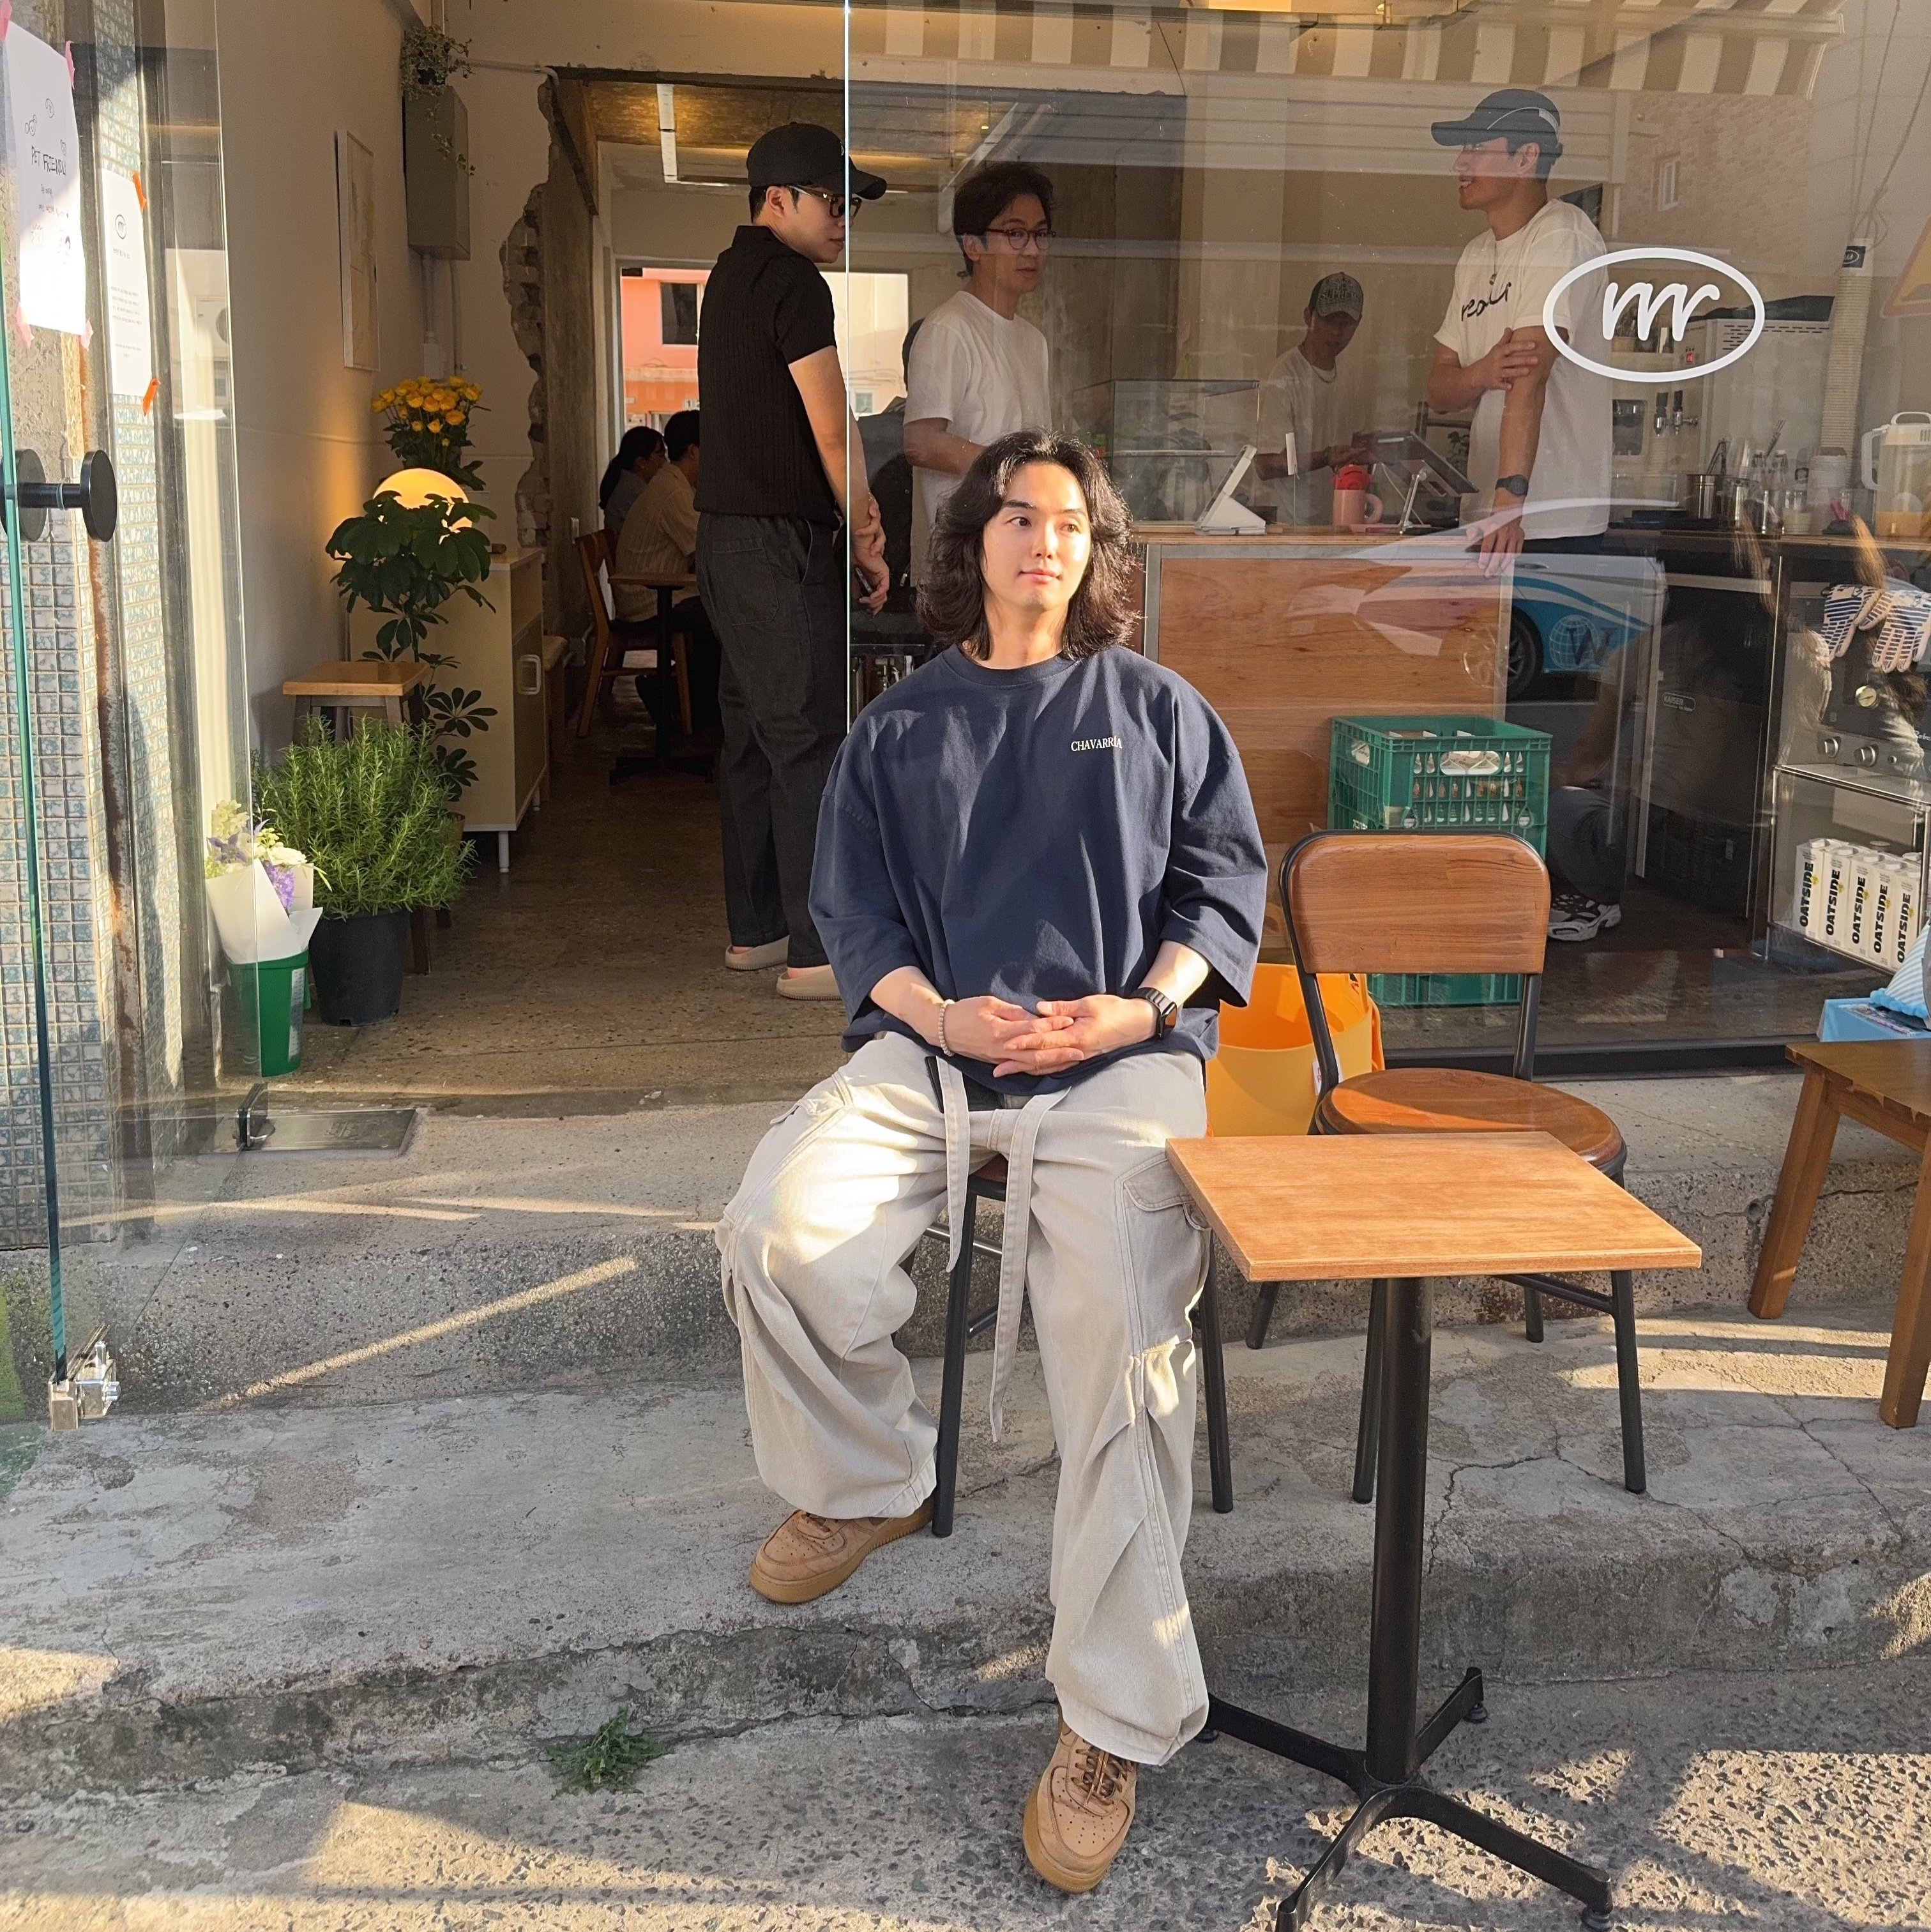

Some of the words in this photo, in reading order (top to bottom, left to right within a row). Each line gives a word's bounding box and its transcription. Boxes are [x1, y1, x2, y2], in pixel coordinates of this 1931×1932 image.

[31, 144, 41, 166] PET
[43, 154, 66, 177] FRIENDLY
[1799, 862, 1814, 927] OATSIDE
[1826, 869, 1840, 936] OATSIDE
[1852, 876, 1866, 944] OATSIDE
[1874, 884, 1888, 954] OATSIDE
[1897, 893, 1911, 963] OATSIDE
